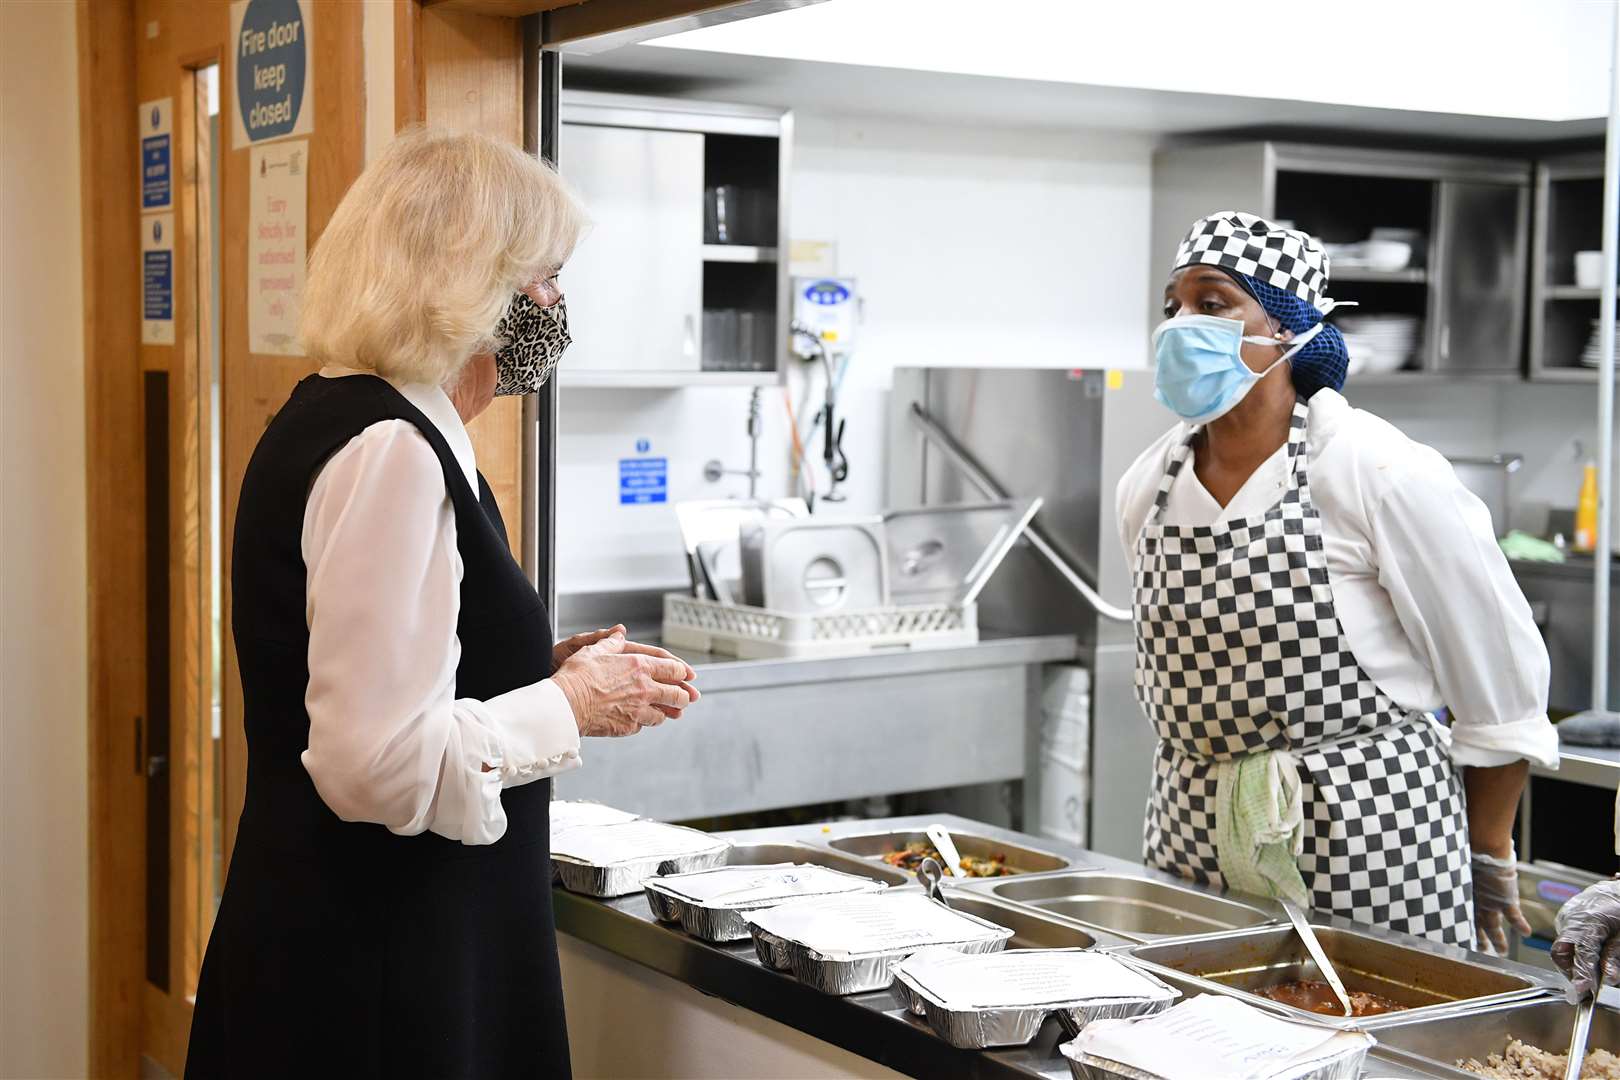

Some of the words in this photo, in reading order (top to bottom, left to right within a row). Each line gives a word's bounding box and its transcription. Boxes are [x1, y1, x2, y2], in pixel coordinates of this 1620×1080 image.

[242, 29, 265, 57] Fire
[268, 20, 300, 49] door
[254, 62, 286, 92] keep
[249, 94, 291, 129] closed
